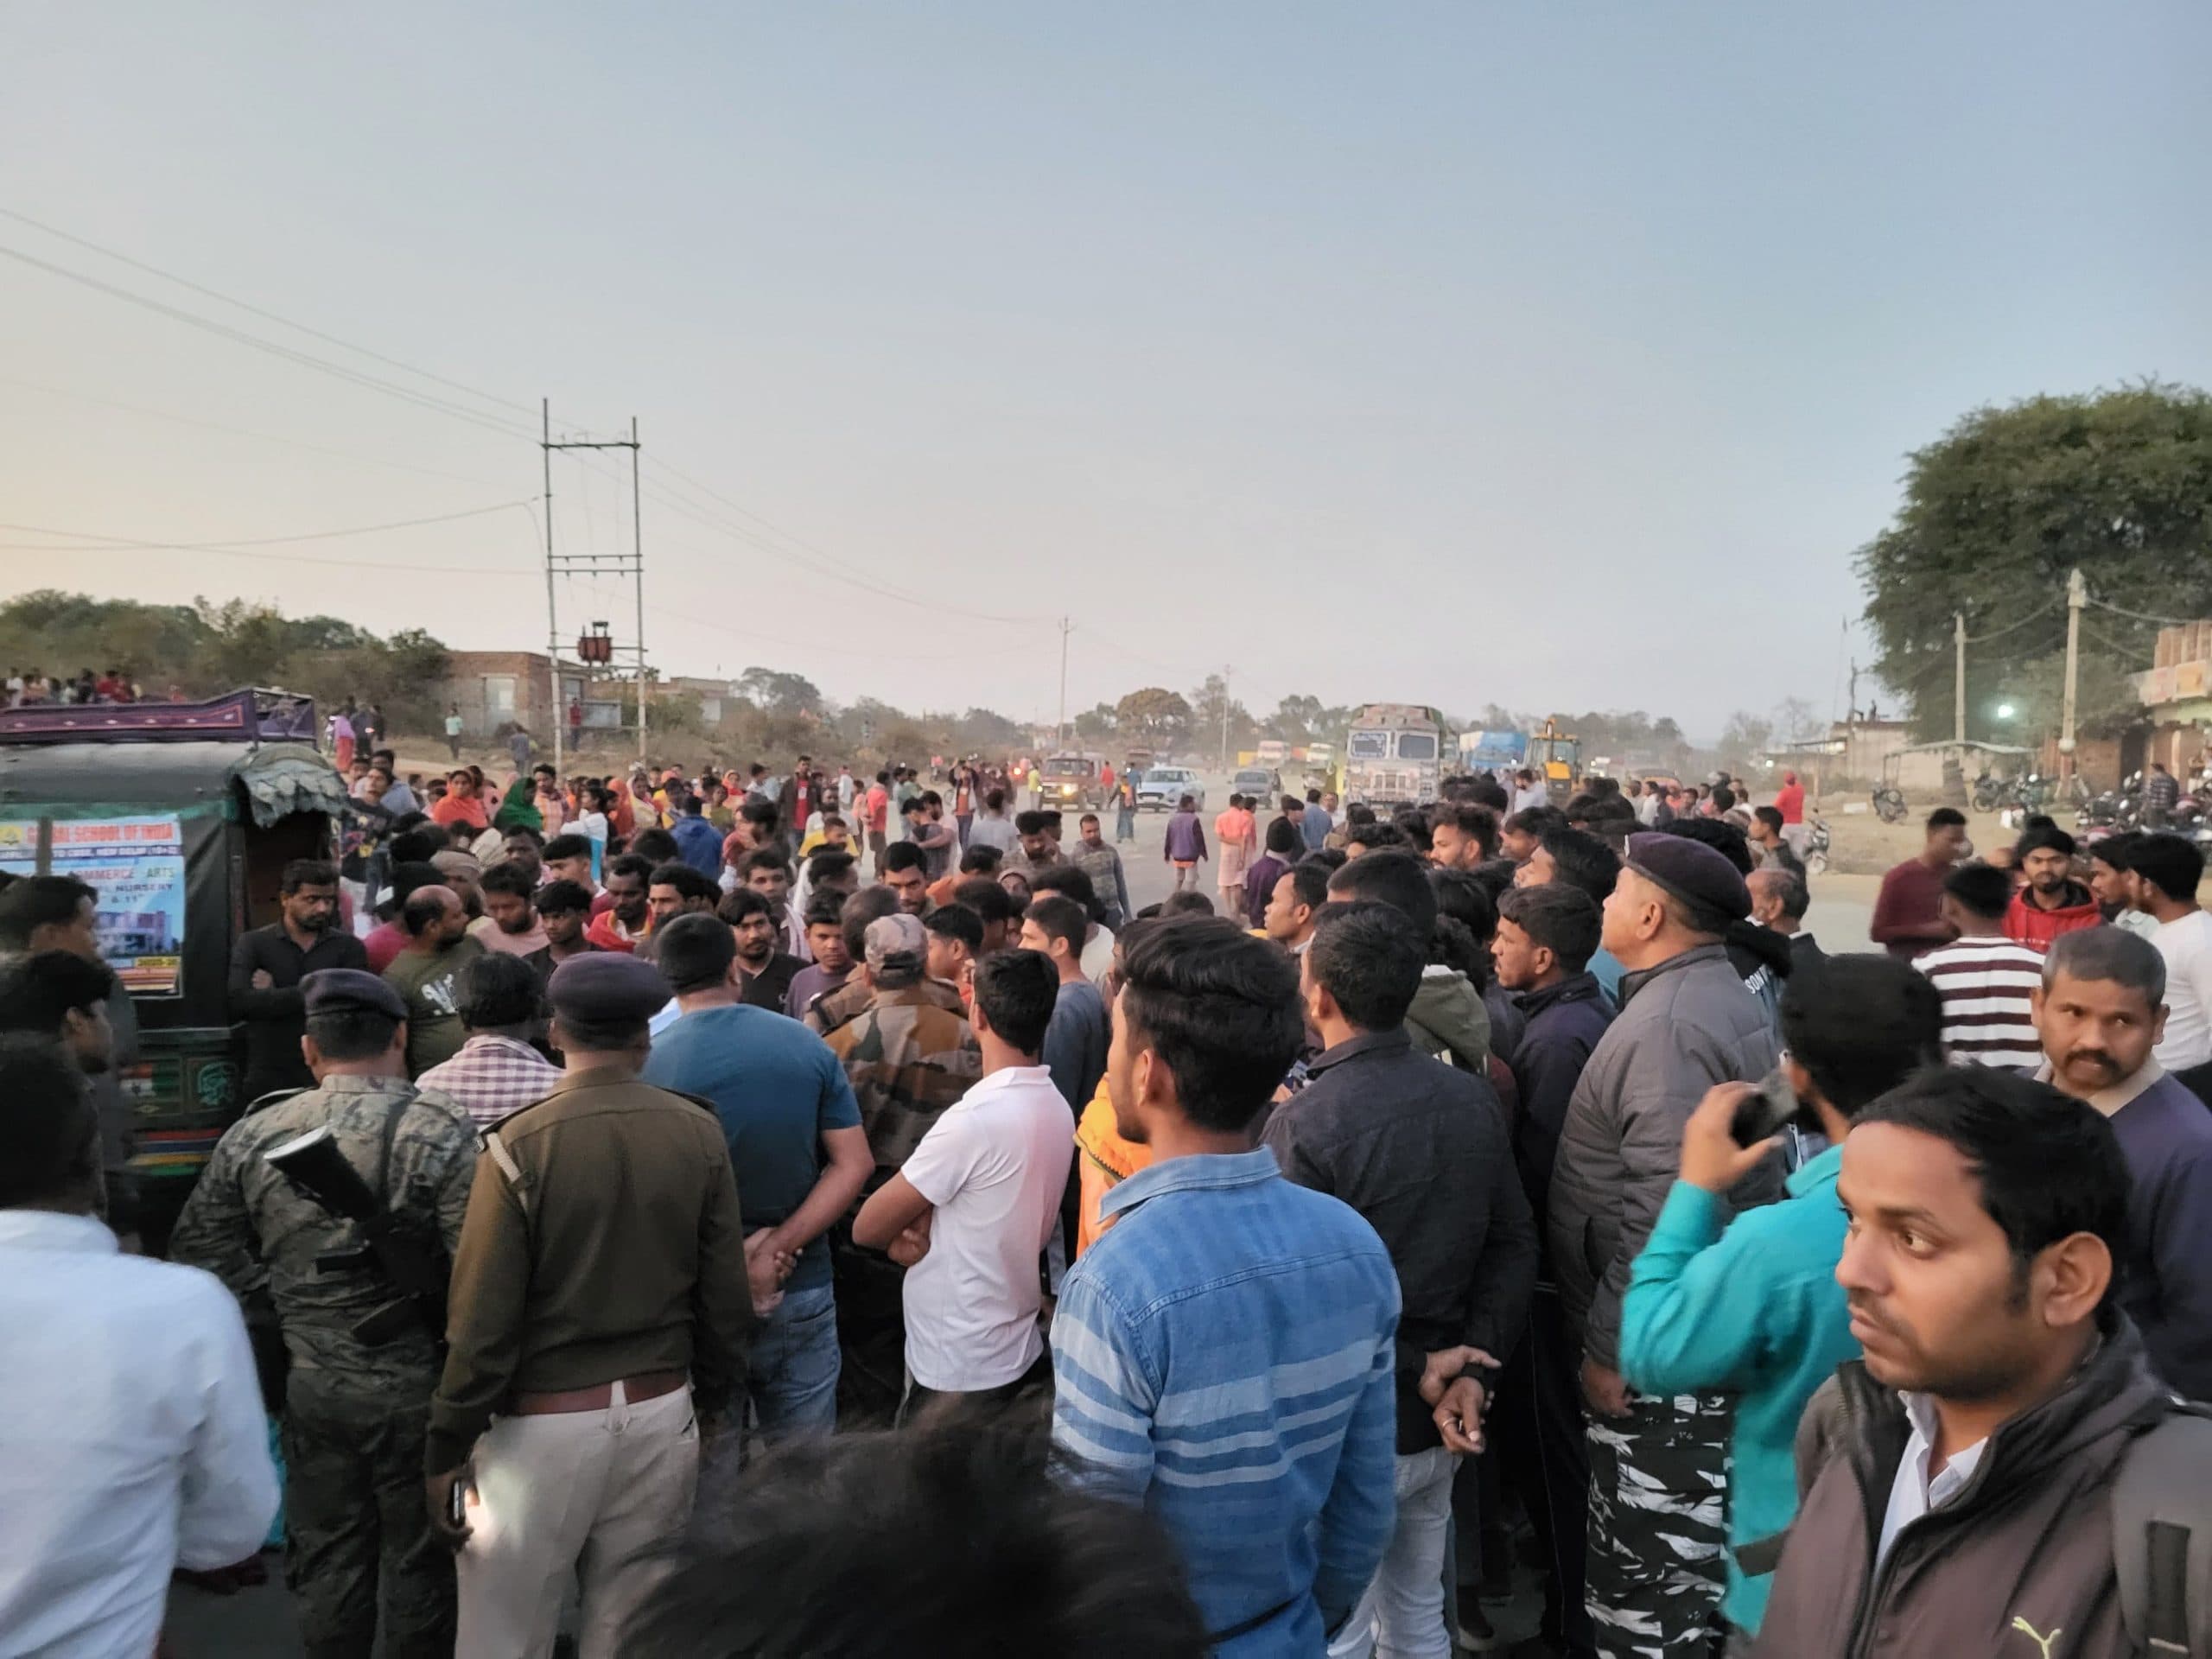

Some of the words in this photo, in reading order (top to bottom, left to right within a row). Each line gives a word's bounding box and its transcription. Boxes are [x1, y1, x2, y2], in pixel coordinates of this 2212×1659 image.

[75, 824, 120, 842] SCHOOL
[74, 868, 135, 880] OMMERCE
[146, 867, 175, 878] ARTS
